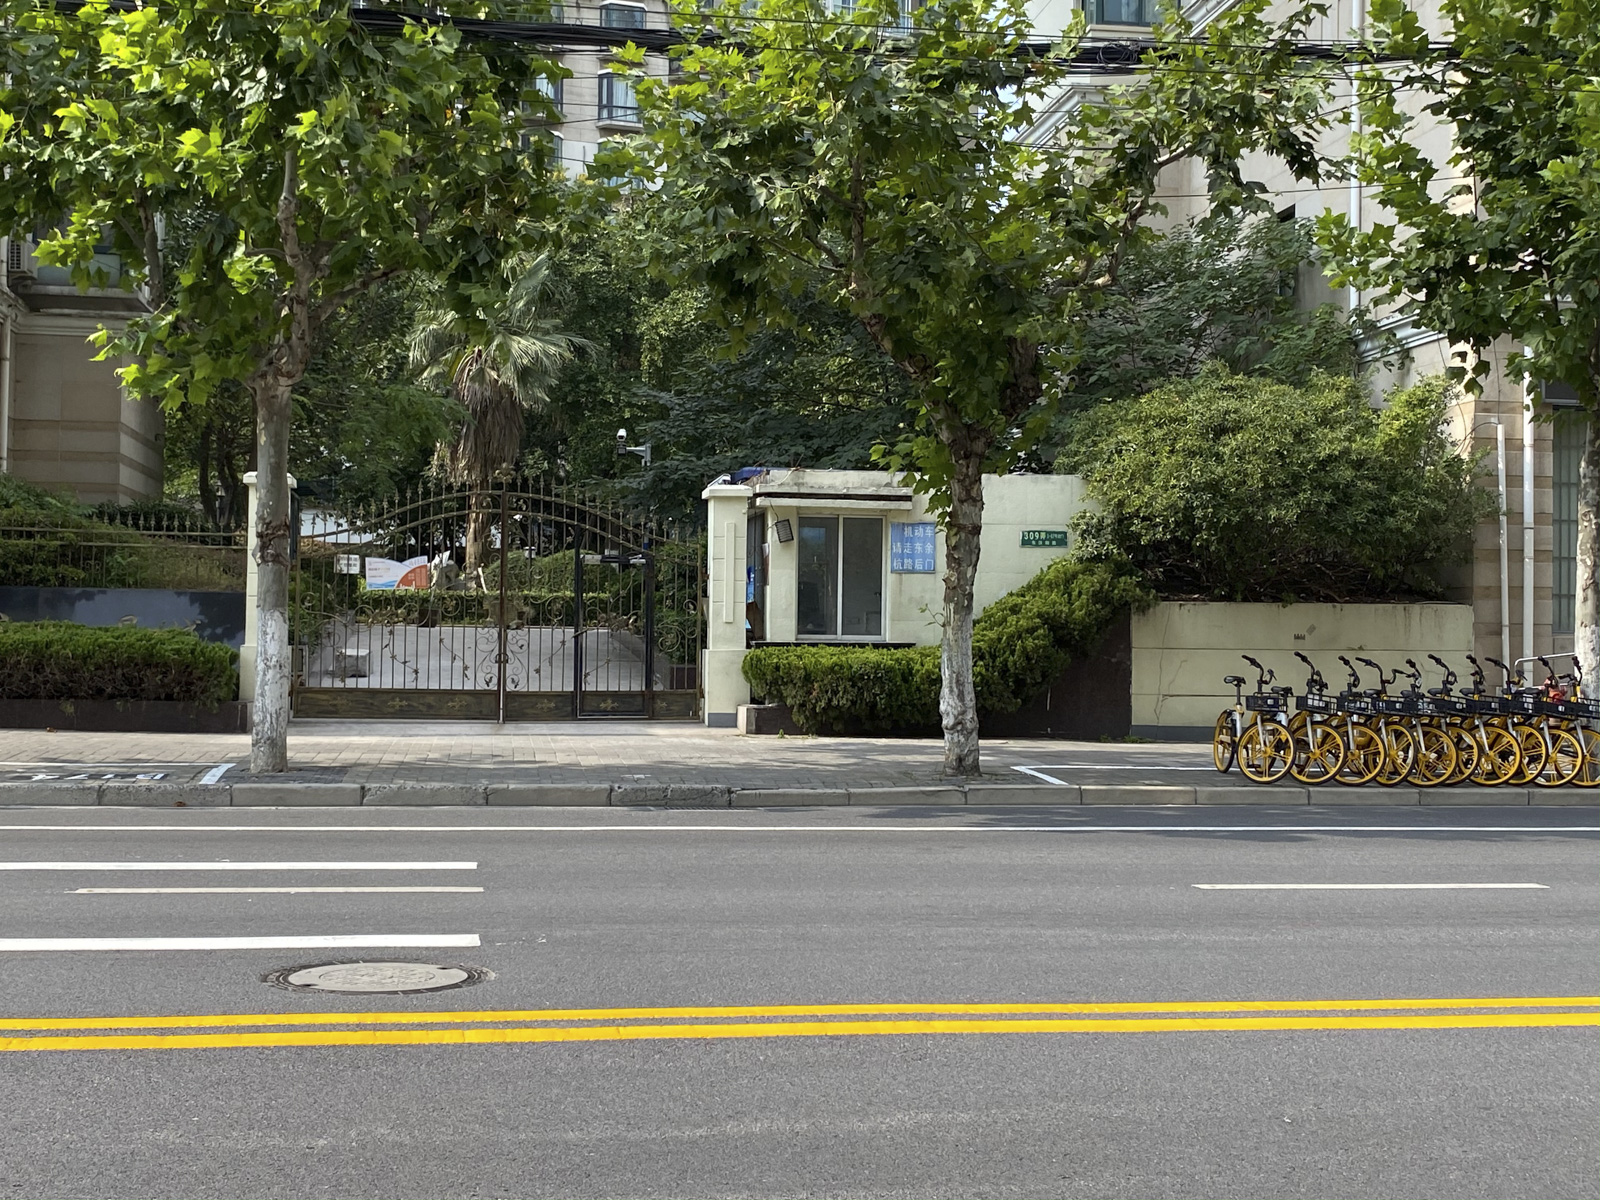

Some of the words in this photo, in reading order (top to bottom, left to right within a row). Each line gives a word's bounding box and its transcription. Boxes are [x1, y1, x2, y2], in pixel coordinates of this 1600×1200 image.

[904, 525, 934, 538] 机动车
[892, 542, 934, 554] 请走东余
[893, 558, 934, 570] 杭路后门
